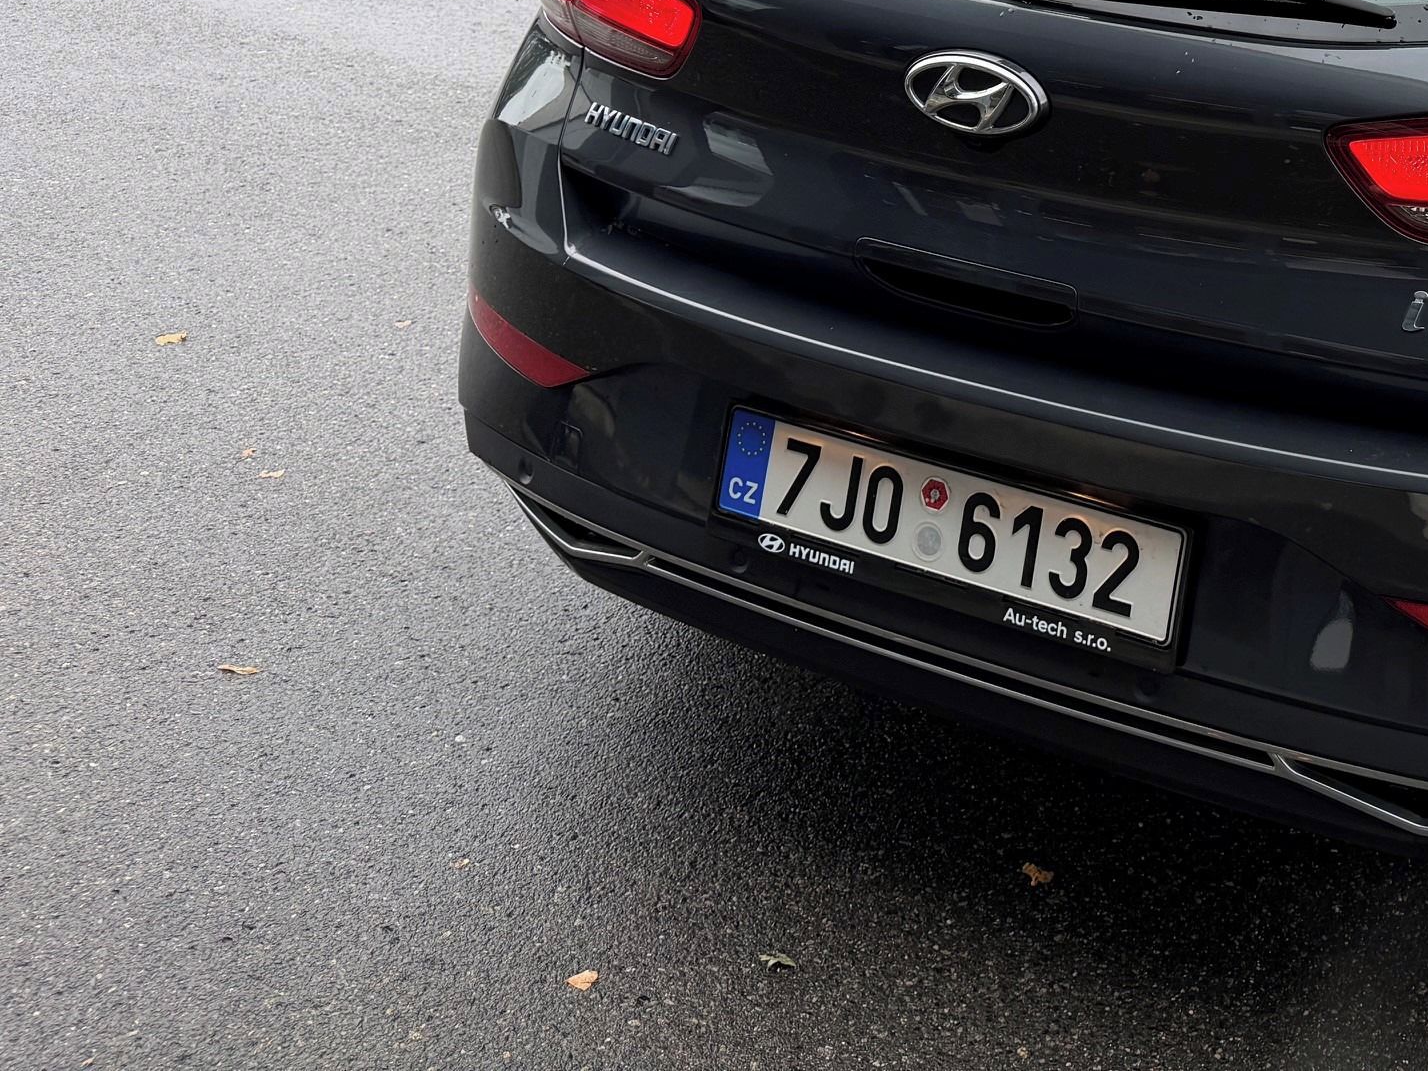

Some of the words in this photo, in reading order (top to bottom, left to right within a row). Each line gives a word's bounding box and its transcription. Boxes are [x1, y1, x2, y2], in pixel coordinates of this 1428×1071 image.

[584, 101, 677, 155] HYUNDAI
[729, 476, 759, 505] CZ
[776, 437, 903, 545] 7J0
[958, 492, 1140, 618] 6132
[789, 542, 855, 575] HYUNDAI
[1003, 608, 1067, 639] Au-tech
[1073, 630, 1112, 653] s.r.o.
